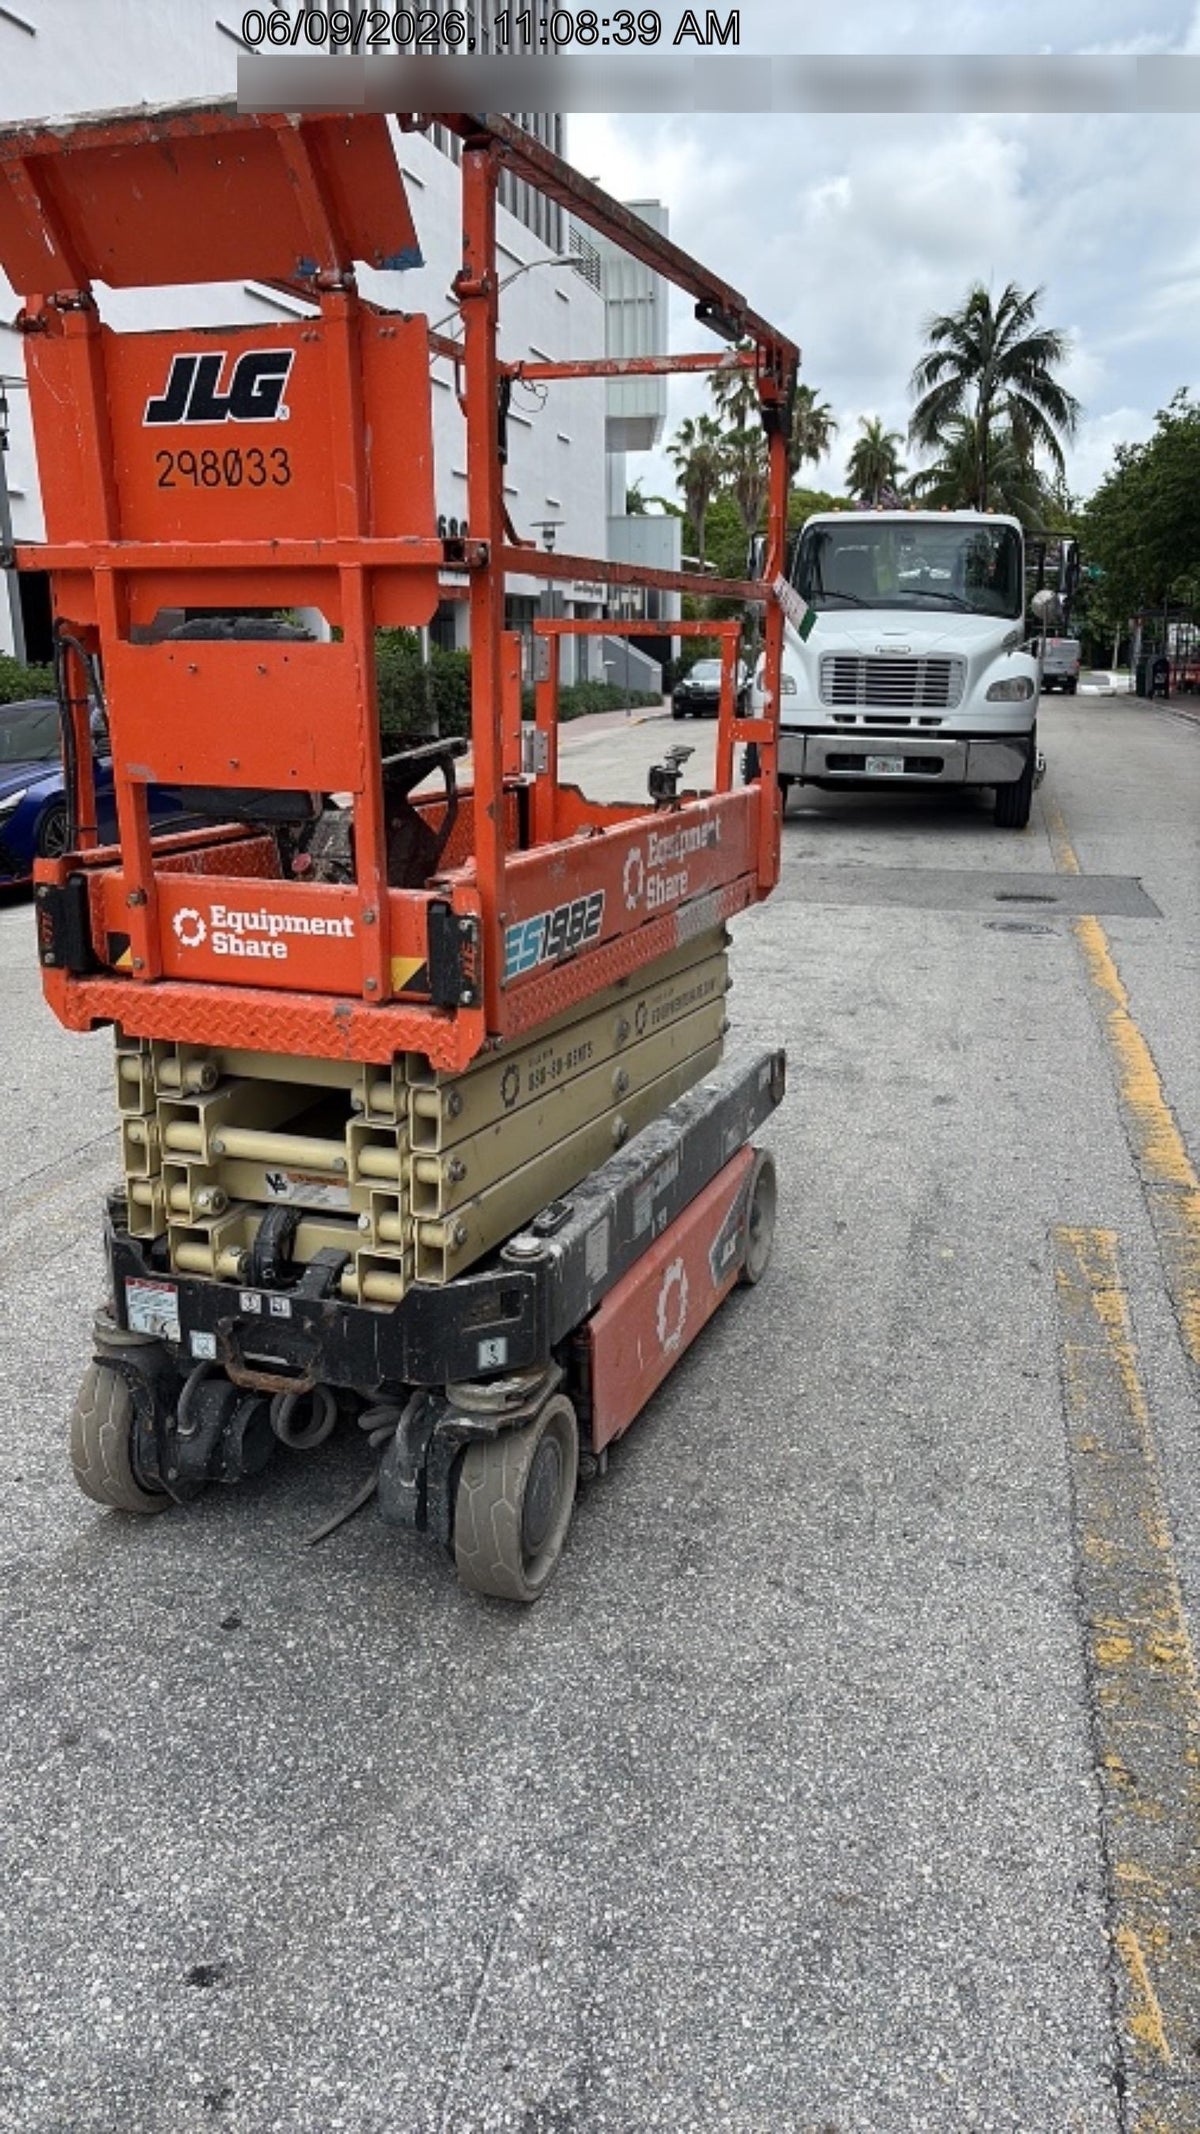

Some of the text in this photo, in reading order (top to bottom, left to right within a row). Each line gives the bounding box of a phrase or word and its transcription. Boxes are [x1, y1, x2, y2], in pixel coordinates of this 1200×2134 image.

[142, 348, 295, 427] JLG
[156, 448, 291, 487] 298033
[647, 871, 688, 911] Share
[210, 905, 354, 937] Equipment
[212, 931, 287, 959] Share
